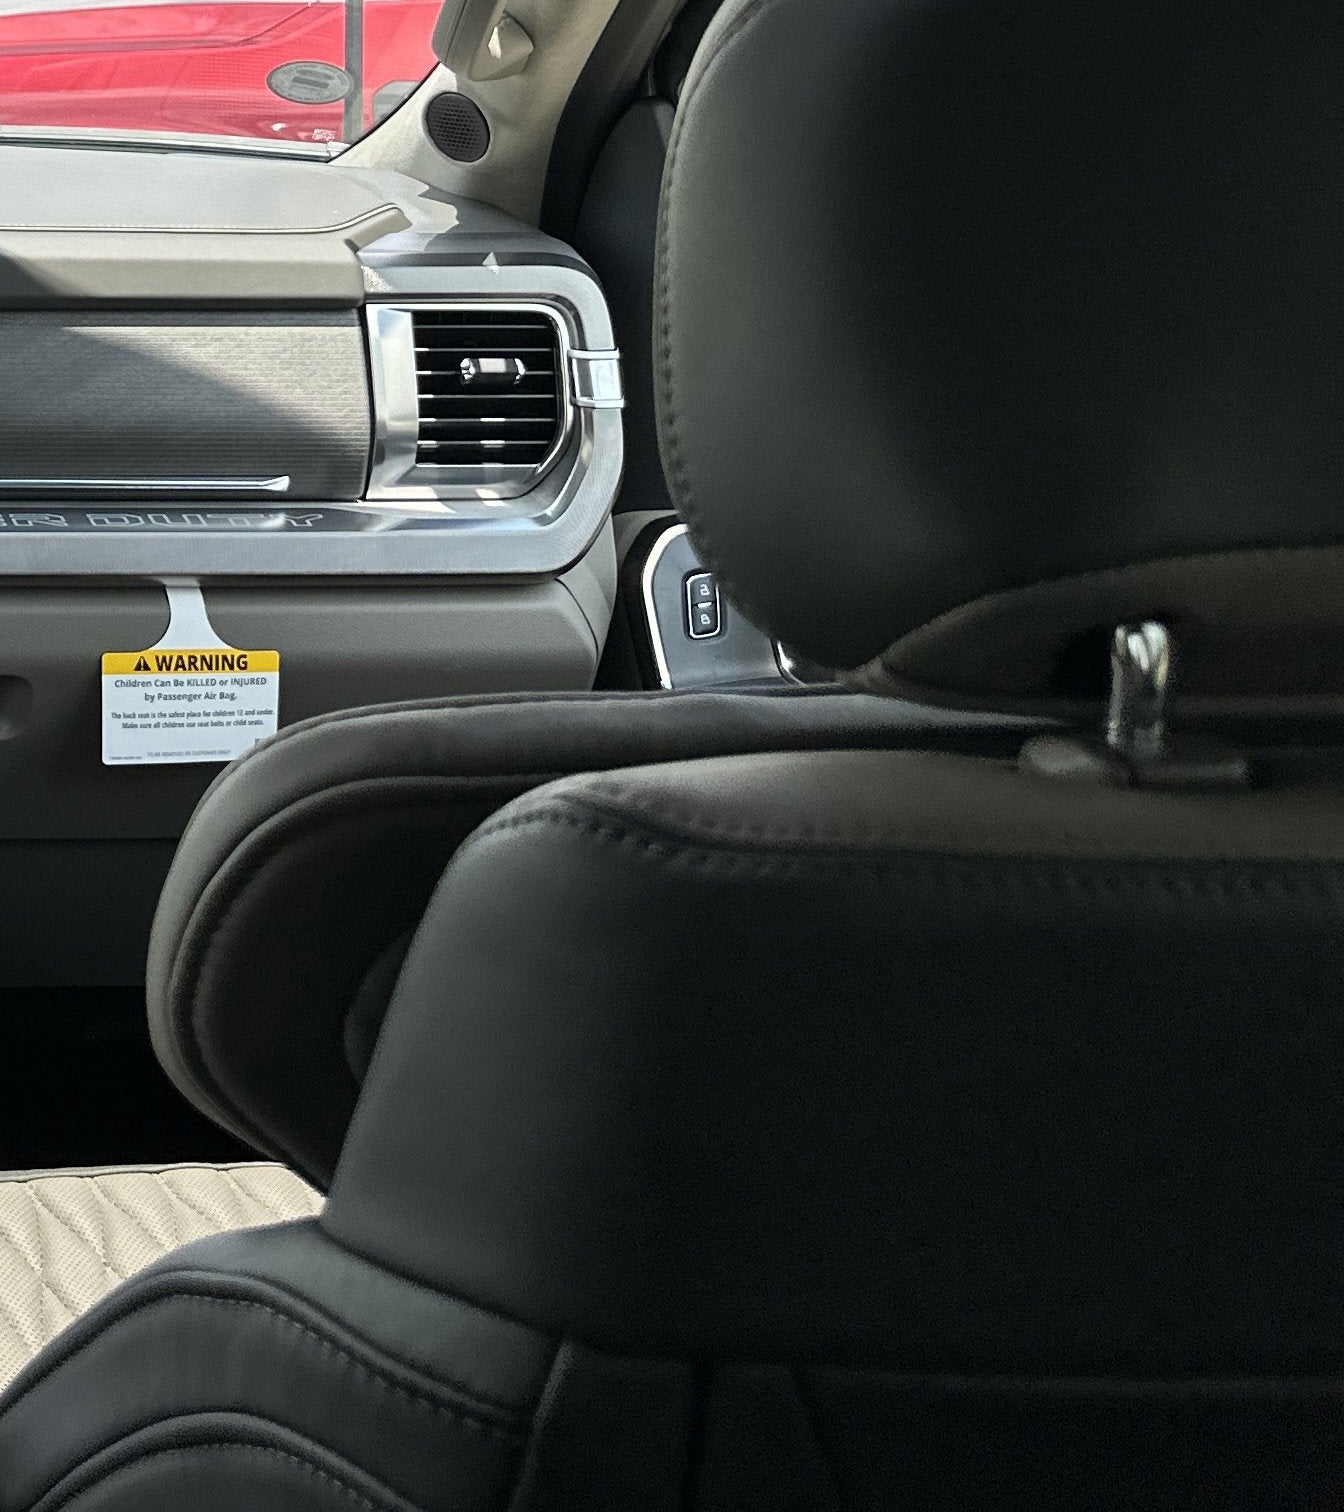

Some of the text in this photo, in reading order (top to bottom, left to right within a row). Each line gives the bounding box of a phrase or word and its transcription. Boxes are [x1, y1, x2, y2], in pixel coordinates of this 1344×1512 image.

[88, 512, 324, 528] DUTY
[155, 654, 248, 672] WARNING
[114, 679, 152, 688] Children
[154, 679, 171, 687] Can
[187, 678, 216, 687] KILLED
[230, 677, 267, 687] INJURED
[144, 692, 155, 702] by
[158, 692, 202, 702] Passenger
